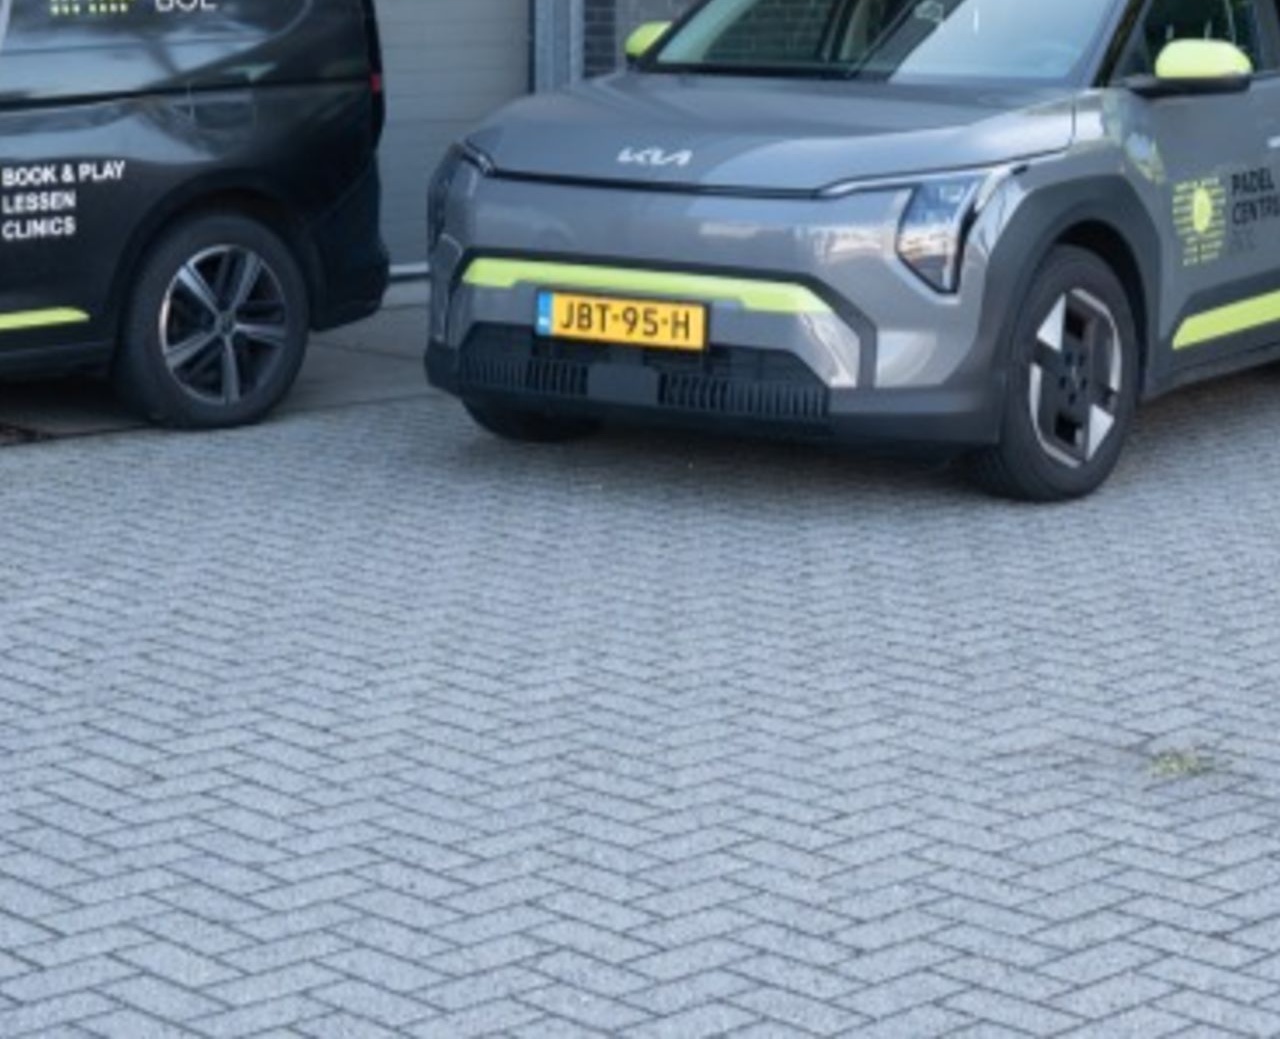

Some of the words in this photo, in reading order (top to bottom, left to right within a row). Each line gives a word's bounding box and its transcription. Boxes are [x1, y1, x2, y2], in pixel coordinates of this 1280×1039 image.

[1, 165, 57, 187] BOOK
[61, 163, 75, 183] &
[78, 160, 125, 182] PLAY
[1, 189, 76, 214] LESSEN
[1, 216, 76, 240] CLINICS
[561, 302, 690, 341] JBT-95-H
